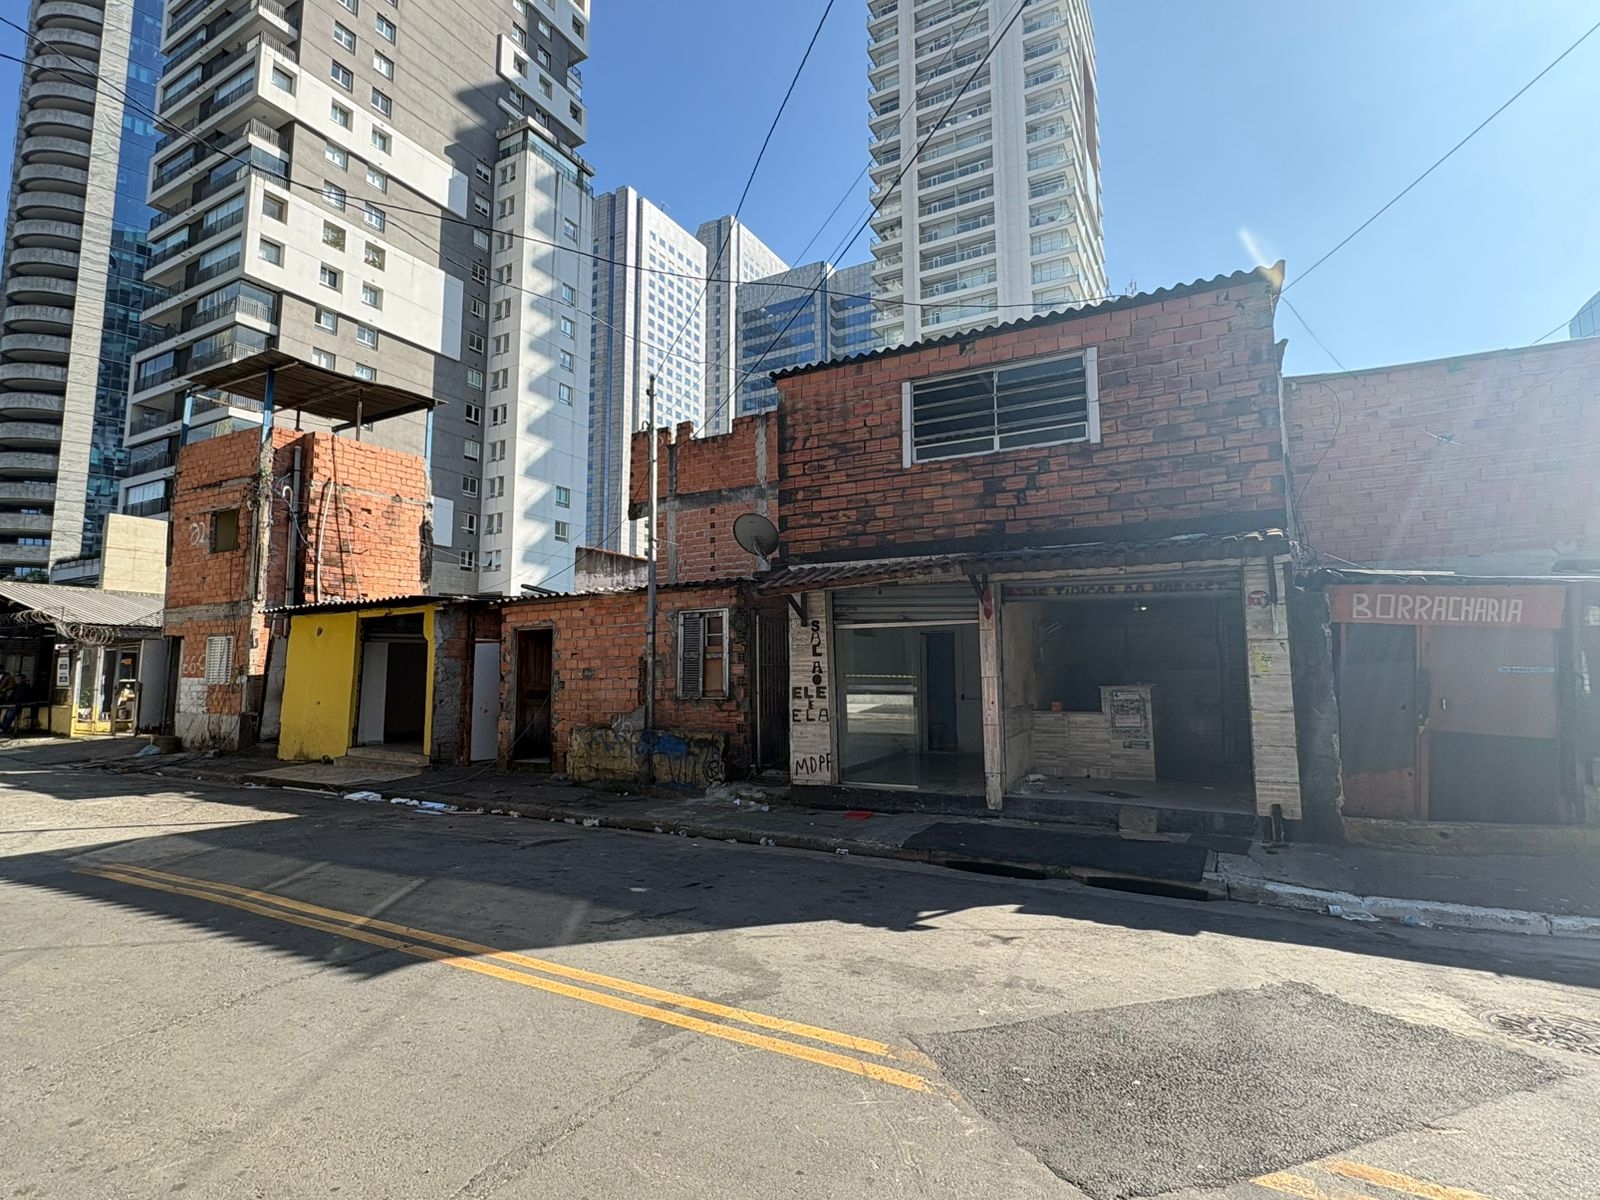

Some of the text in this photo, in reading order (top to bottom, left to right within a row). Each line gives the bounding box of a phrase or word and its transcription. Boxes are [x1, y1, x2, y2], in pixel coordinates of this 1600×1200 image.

[1352, 593, 1523, 623] BORRACHARIA
[792, 686, 827, 699] ELE
[808, 700, 815, 710] E
[792, 708, 829, 722] ELA
